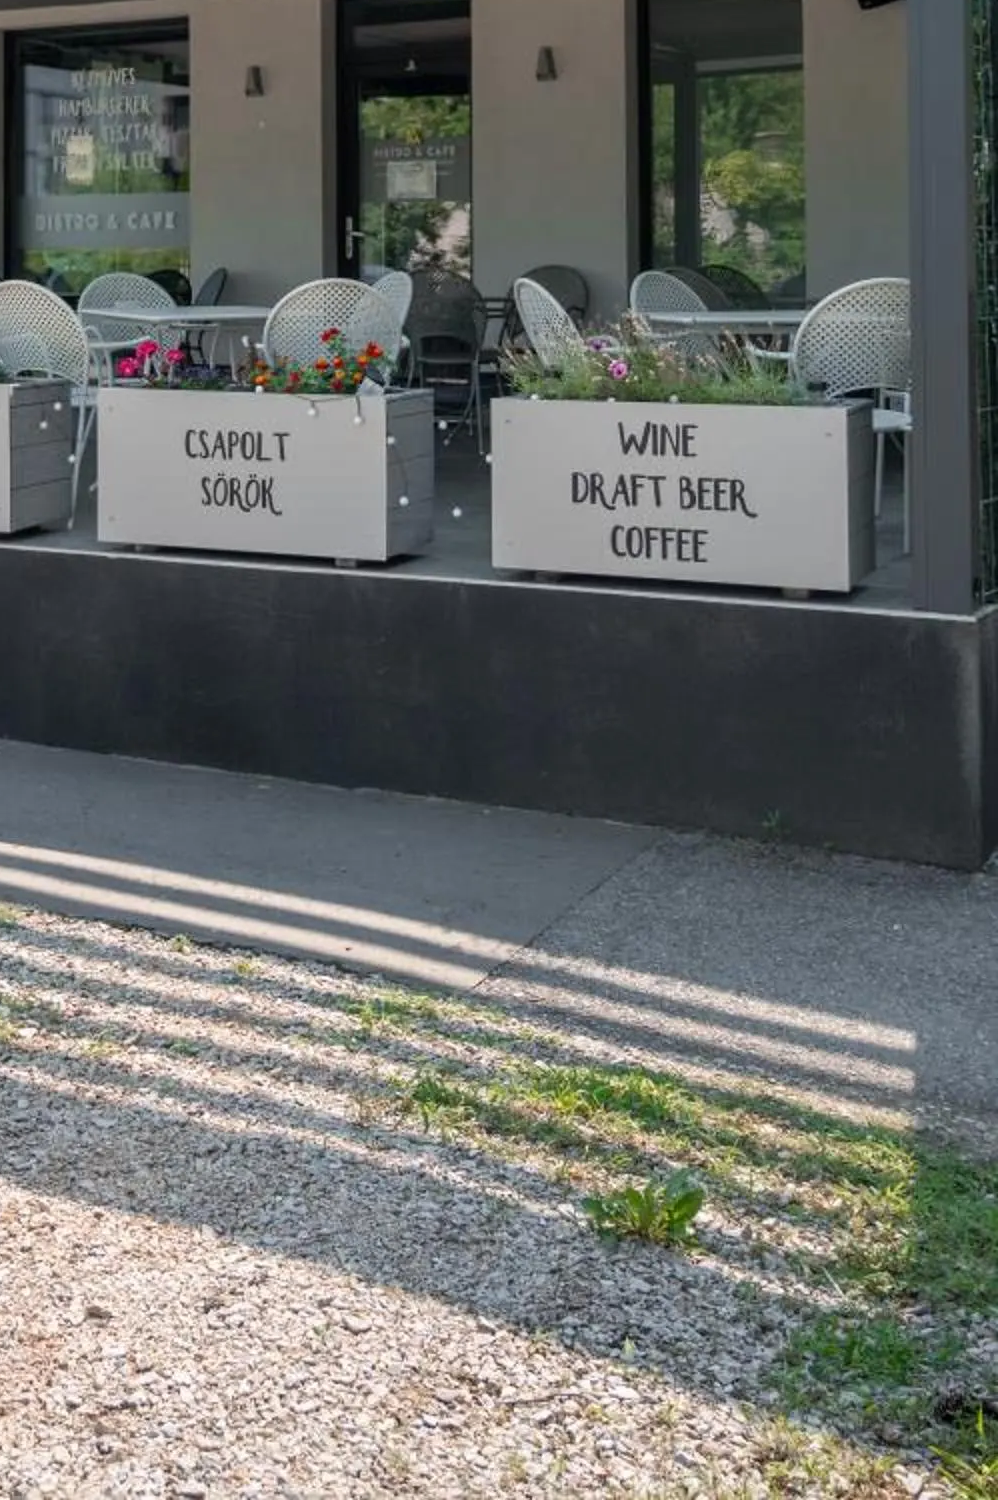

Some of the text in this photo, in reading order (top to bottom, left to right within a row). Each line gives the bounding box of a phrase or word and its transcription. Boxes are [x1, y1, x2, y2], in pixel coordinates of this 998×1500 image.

[35, 212, 100, 231] BISTRO
[107, 213, 119, 230] &
[184, 429, 290, 463] CSAPOLT
[617, 421, 699, 458] WINE
[200, 473, 283, 515] SÖRÖK
[570, 471, 758, 518] DRAFT BEER
[610, 525, 709, 563] COFFEE
